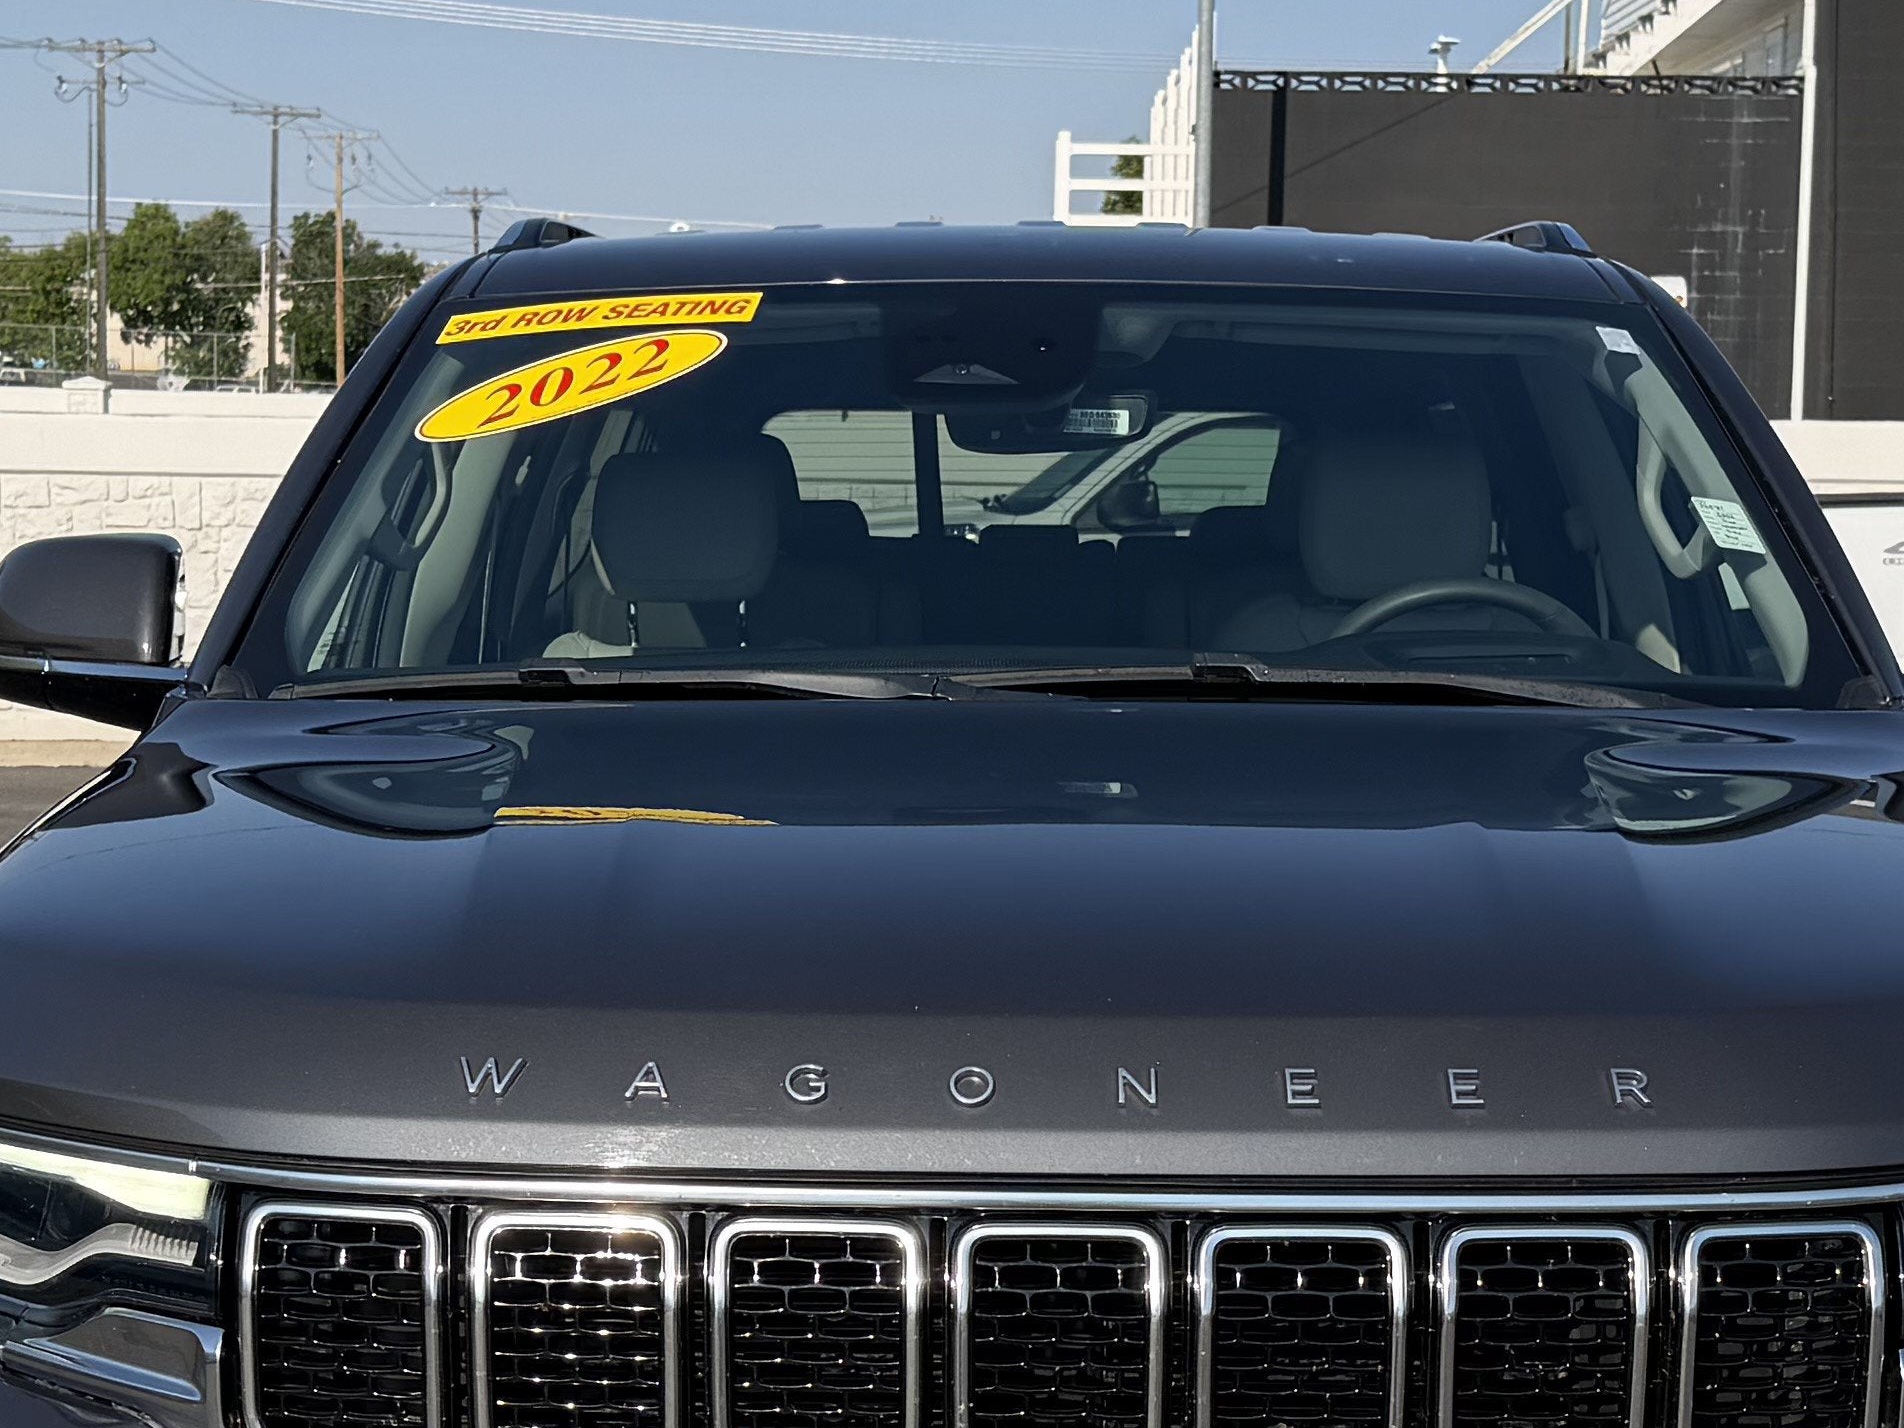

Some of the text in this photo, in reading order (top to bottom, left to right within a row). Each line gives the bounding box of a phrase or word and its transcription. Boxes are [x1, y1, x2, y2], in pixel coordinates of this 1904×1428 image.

[444, 298, 752, 337] 3rd ROW SEATING
[476, 338, 670, 429] 2022
[459, 1055, 1654, 1110] WAGONEER
